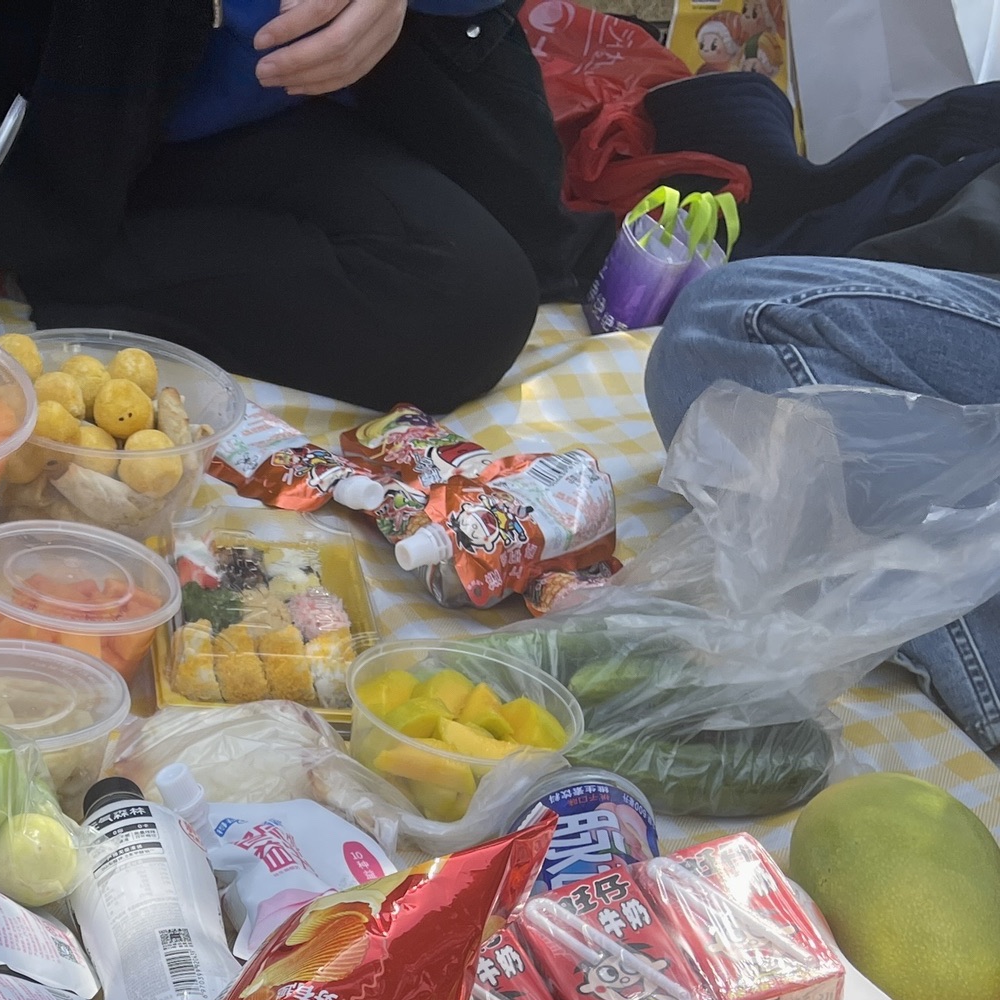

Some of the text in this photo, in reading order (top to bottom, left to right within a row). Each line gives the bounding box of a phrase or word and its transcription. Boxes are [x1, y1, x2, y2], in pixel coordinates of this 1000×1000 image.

[548, 784, 610, 804] 维生素饮料
[598, 898, 652, 939] 牛奶
[477, 944, 526, 987] 牛奶
